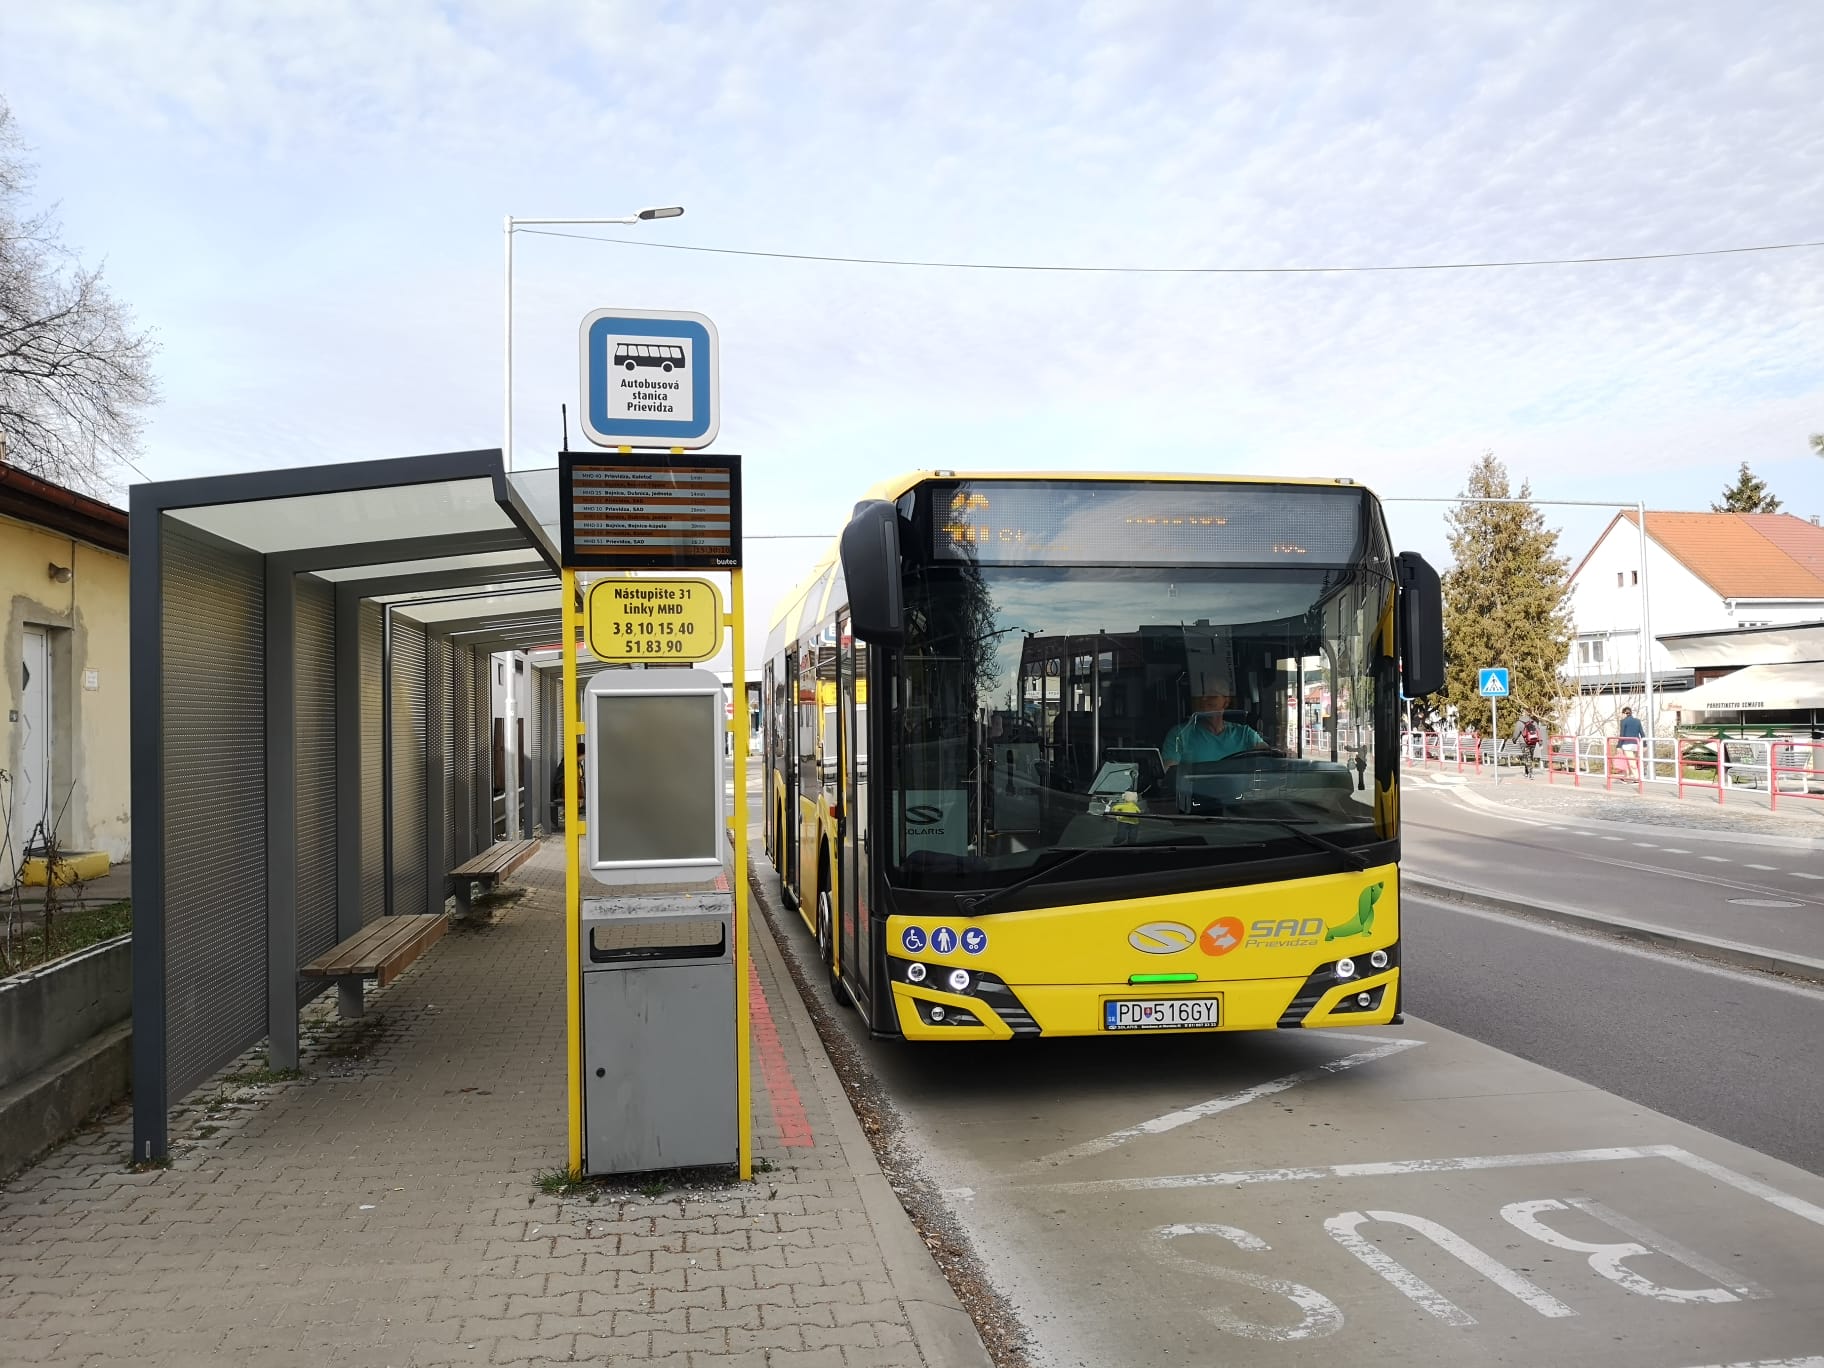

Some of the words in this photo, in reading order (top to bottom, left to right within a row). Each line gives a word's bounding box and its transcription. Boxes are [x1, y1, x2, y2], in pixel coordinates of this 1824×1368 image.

[620, 378, 680, 390] Autobusová
[632, 391, 668, 401] stanica
[627, 401, 674, 413] Prievidza
[614, 587, 676, 602] Nástupište
[679, 588, 692, 600] 31
[623, 603, 655, 617] Linky
[657, 604, 683, 615] MHD
[1248, 917, 1324, 938] SAD
[1244, 938, 1319, 949] Prievidza
[1119, 1004, 1142, 1023] PD
[1154, 1002, 1213, 1022] 516GY
[1148, 1197, 1774, 1343] BUS
